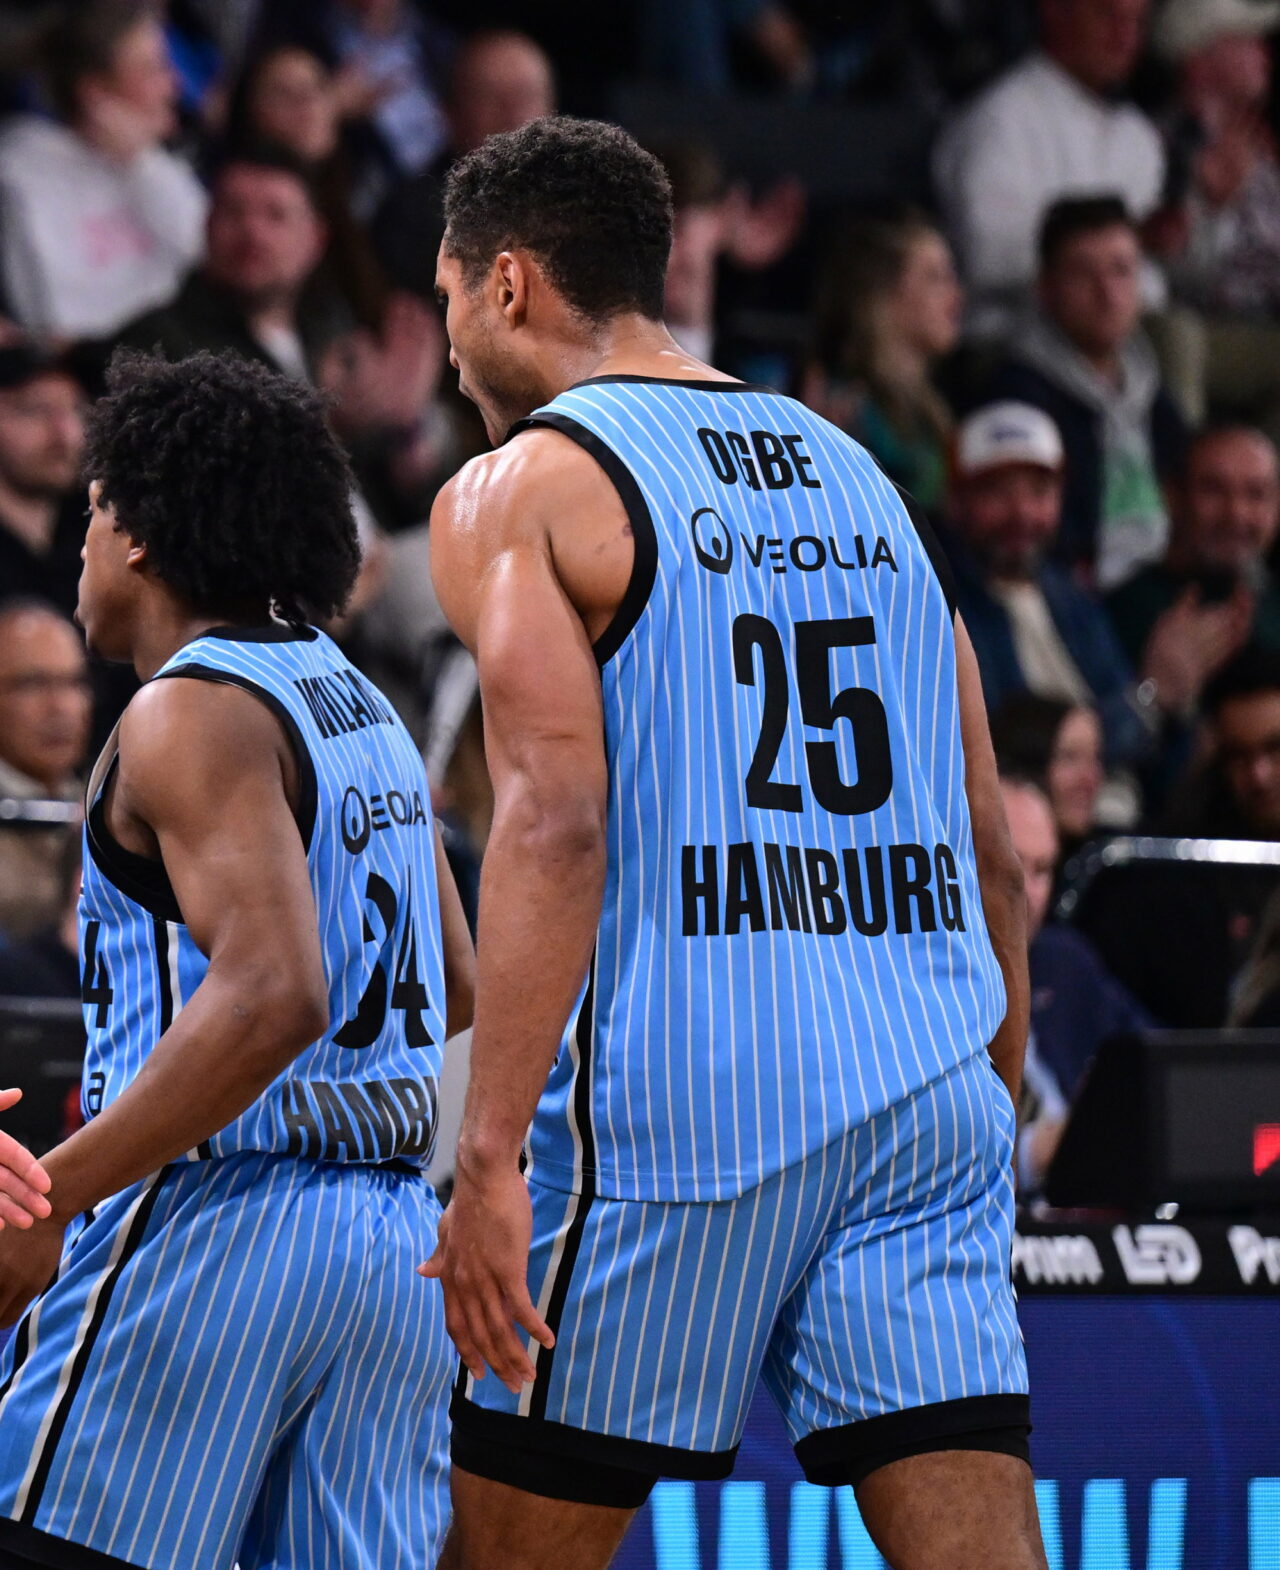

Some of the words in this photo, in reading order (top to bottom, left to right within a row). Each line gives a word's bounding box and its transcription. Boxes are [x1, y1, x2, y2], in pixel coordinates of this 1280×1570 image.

[697, 427, 822, 491] OGBE
[740, 534, 899, 573] VEOLIA
[731, 613, 893, 816] 25
[681, 841, 967, 937] HAMBURG
[82, 921, 113, 1029] 4
[281, 1076, 439, 1163] HAMB
